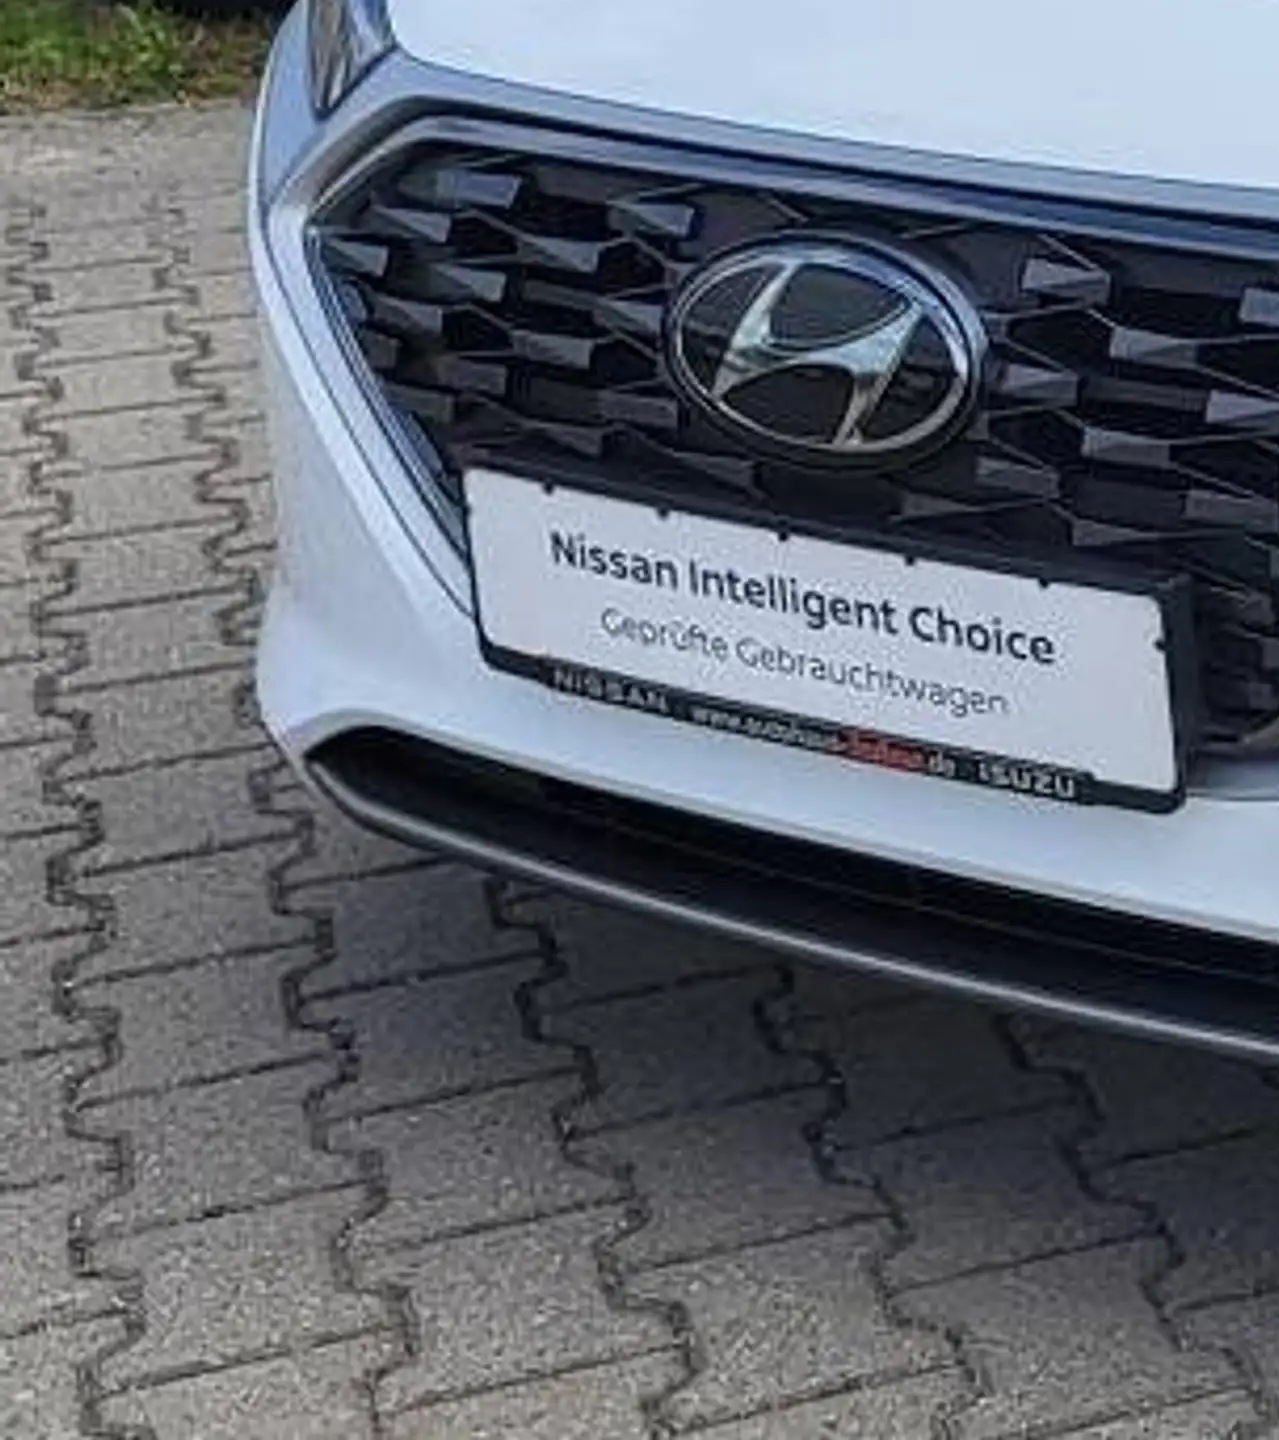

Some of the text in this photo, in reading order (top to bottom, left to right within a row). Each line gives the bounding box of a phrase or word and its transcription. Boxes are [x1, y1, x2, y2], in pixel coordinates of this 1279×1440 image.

[551, 529, 1055, 665] Nissan Intelligent Choice
[601, 608, 1008, 718] Geprüfte Gebrauchtwagen
[977, 758, 1076, 799] ISUZU
